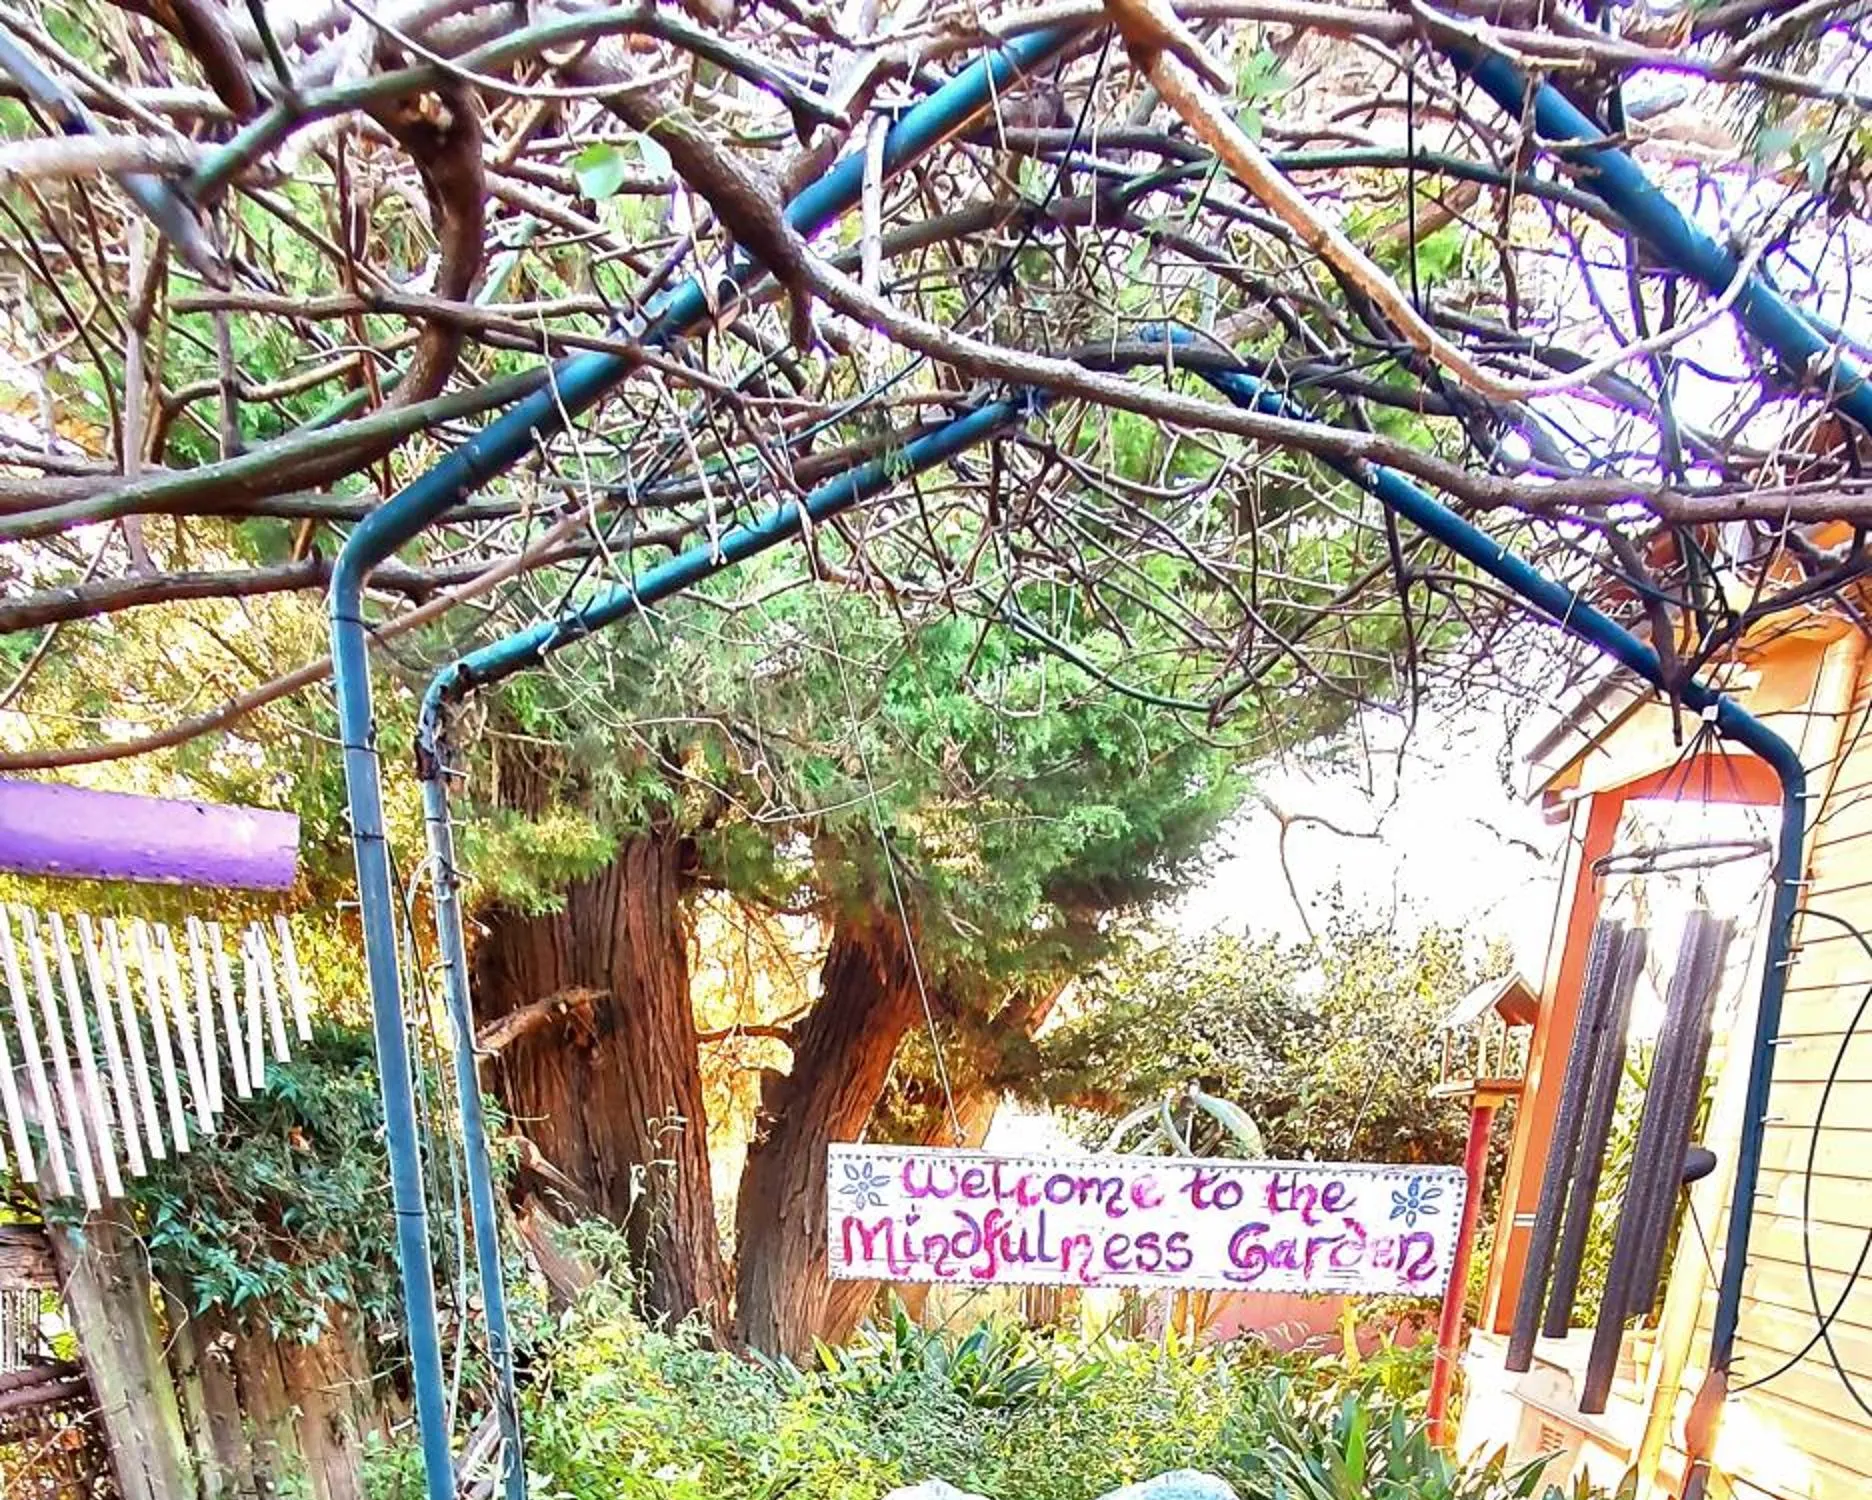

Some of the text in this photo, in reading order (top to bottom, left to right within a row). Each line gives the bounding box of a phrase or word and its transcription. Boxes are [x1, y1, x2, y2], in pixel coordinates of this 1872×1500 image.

[1180, 1168, 1244, 1210] to
[1266, 1172, 1358, 1227] the
[841, 1205, 1439, 1284] Mindfulness Garden
